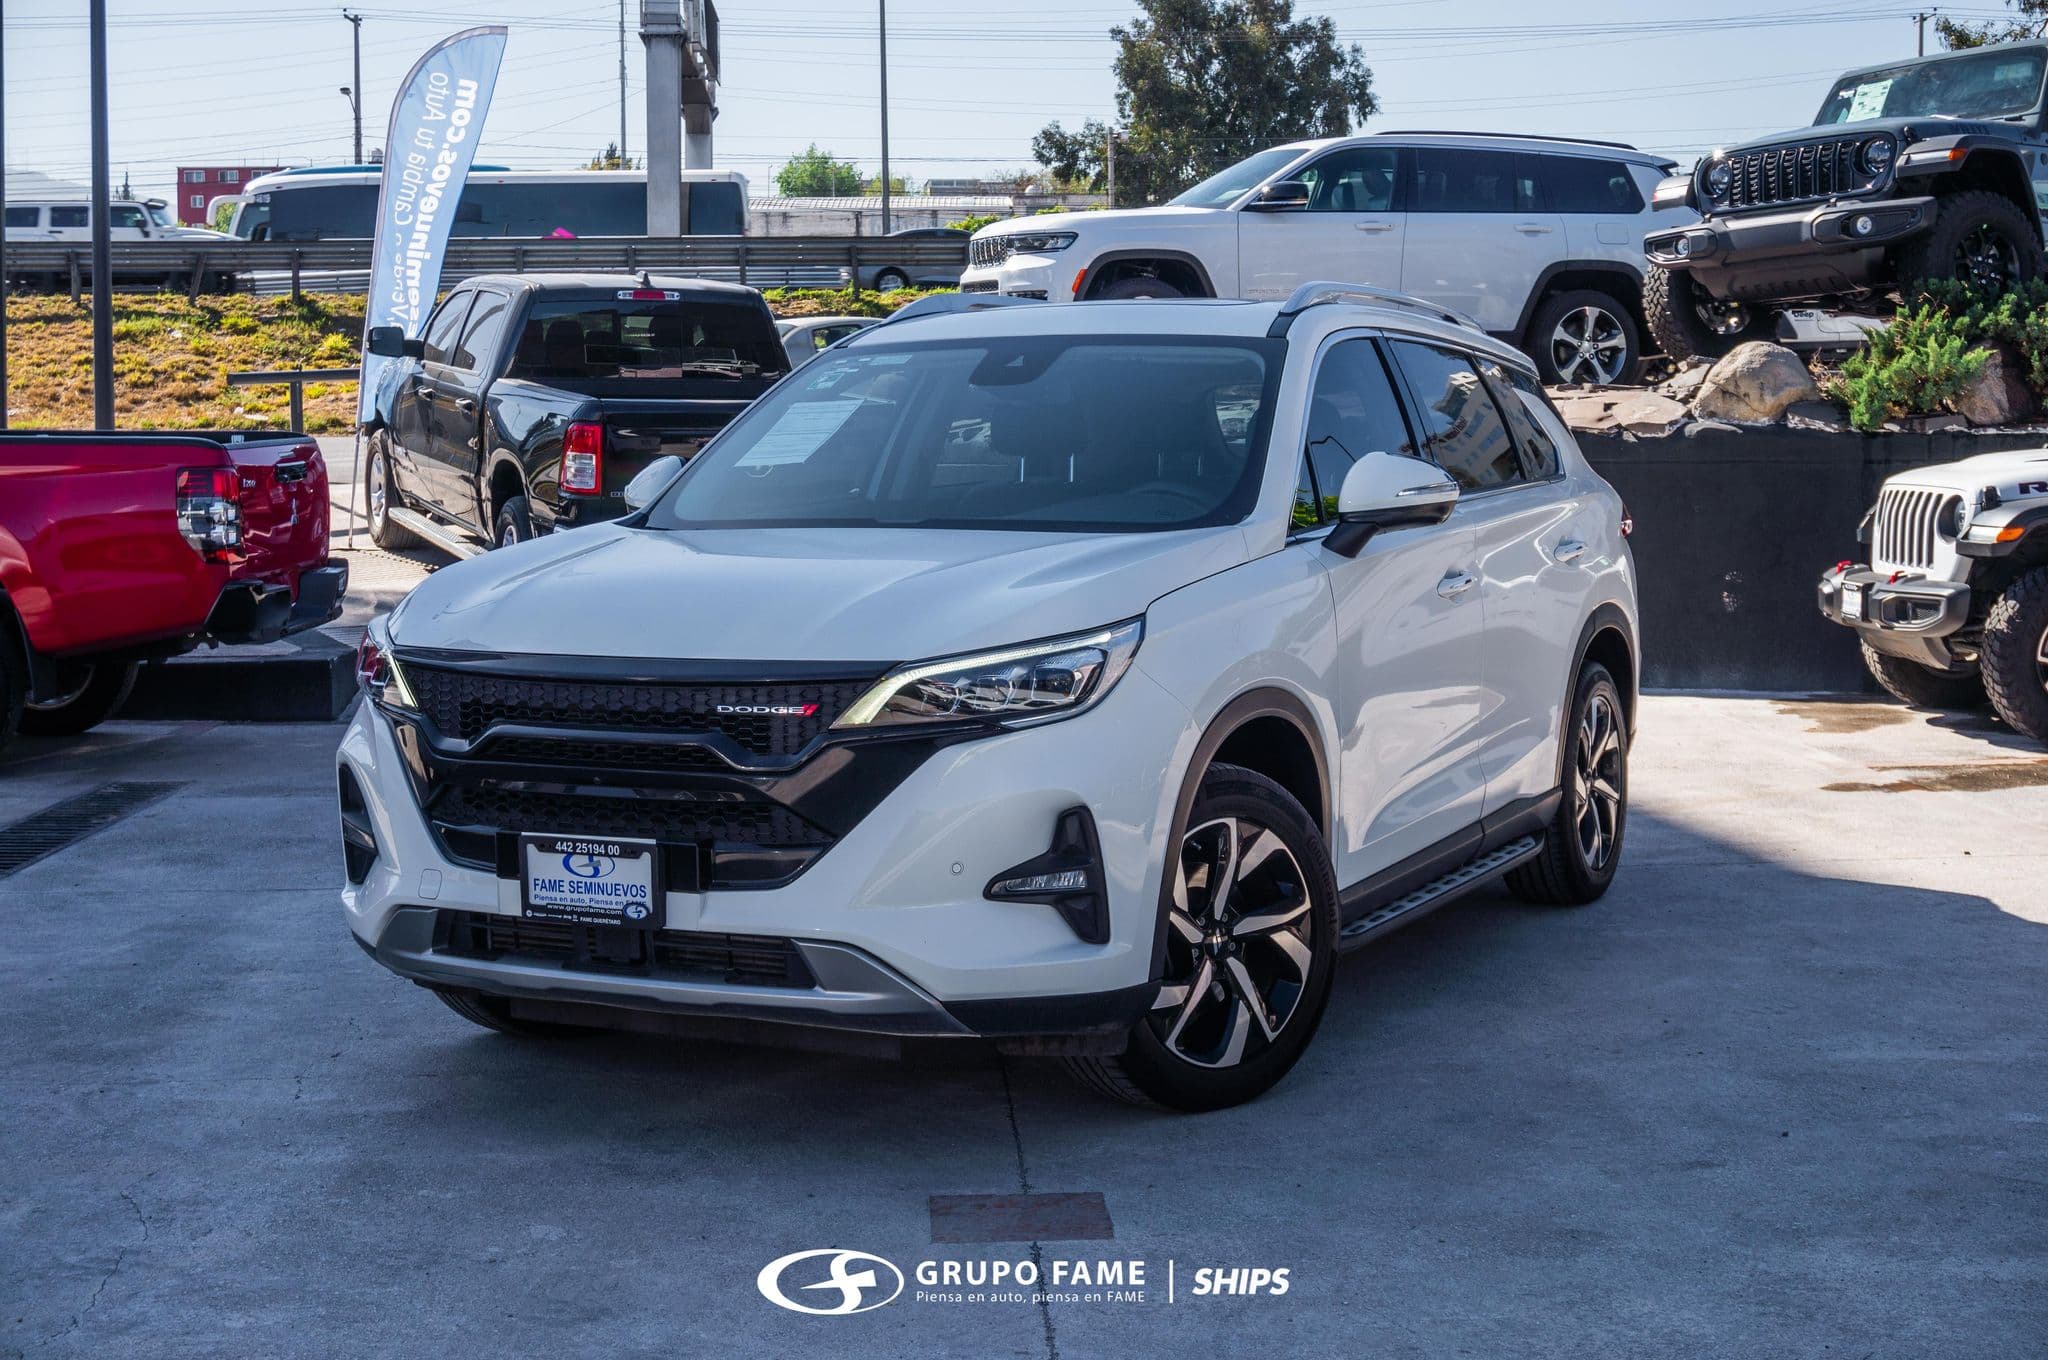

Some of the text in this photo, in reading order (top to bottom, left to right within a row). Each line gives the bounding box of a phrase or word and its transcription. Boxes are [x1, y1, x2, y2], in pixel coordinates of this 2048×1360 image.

[717, 705, 804, 714] DODGE
[555, 841, 620, 856] 442 25194 00
[533, 878, 647, 898] FAME SEMINUEVOS
[534, 894, 558, 902] Piensa
[589, 897, 614, 906] Piensa
[615, 899, 624, 907] en
[547, 904, 622, 915] www.grupofame.com
